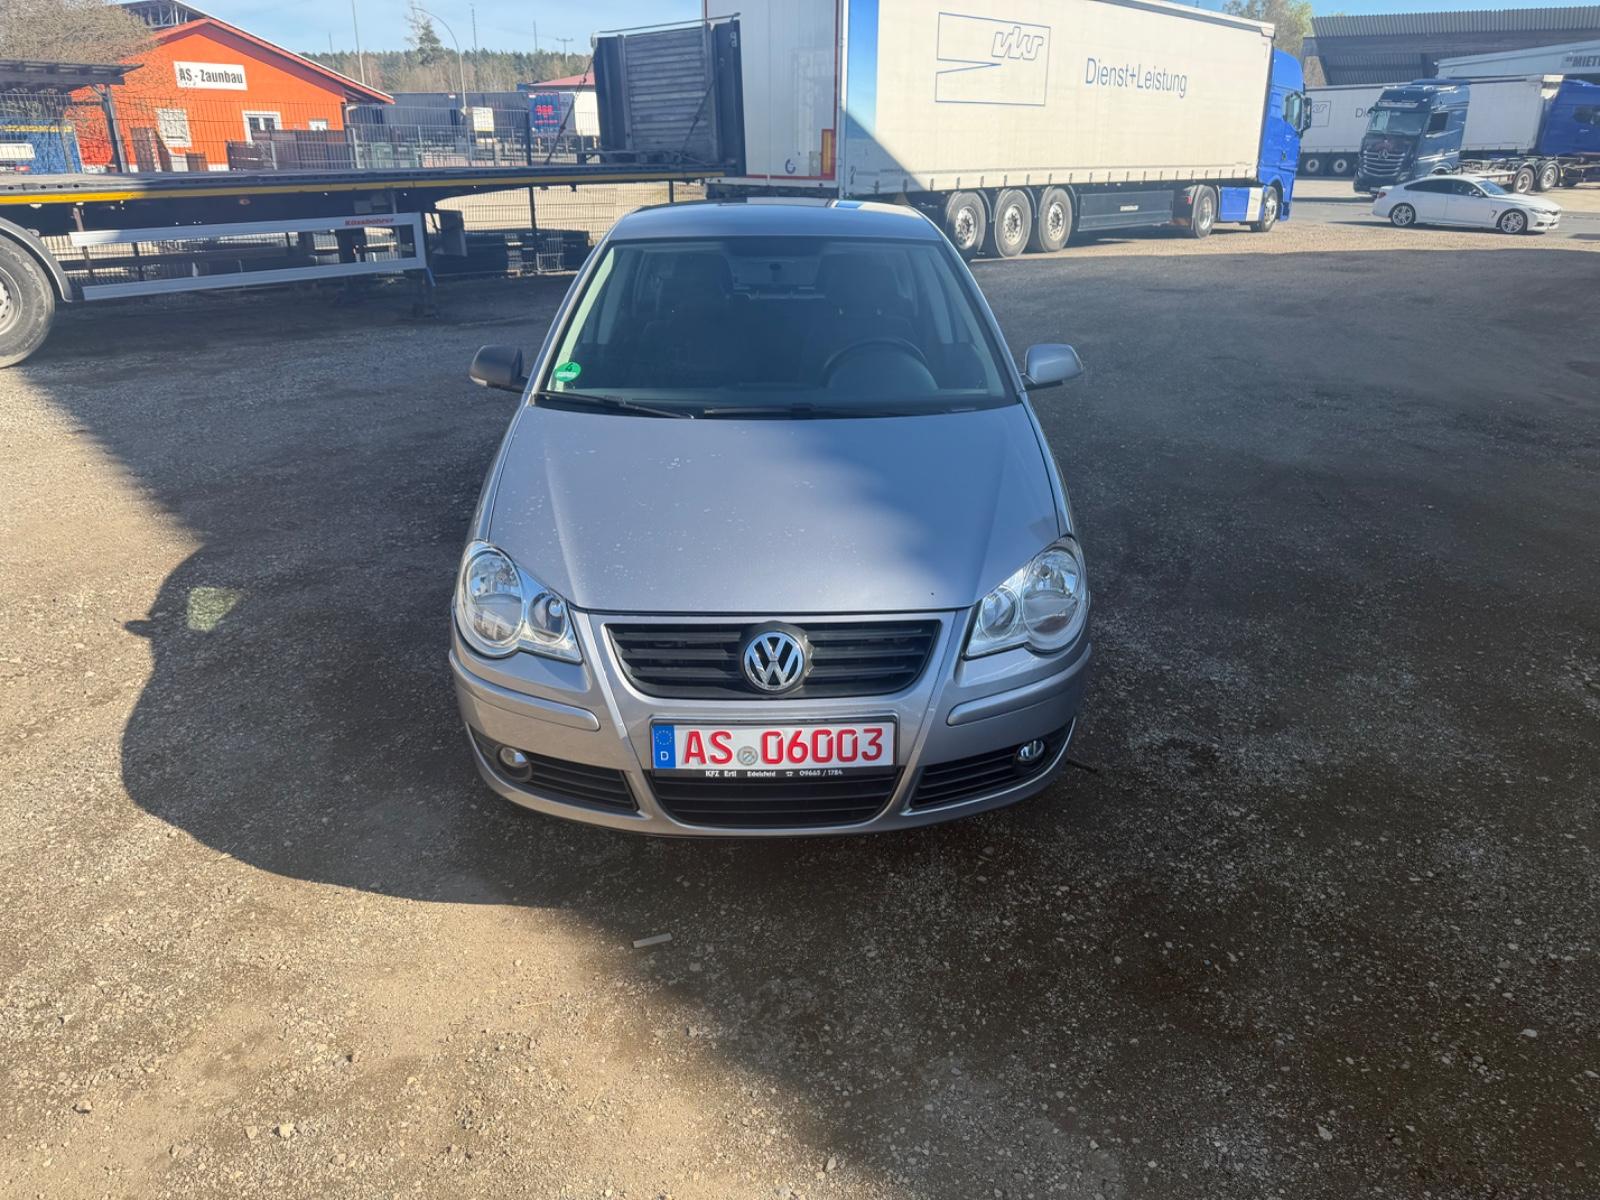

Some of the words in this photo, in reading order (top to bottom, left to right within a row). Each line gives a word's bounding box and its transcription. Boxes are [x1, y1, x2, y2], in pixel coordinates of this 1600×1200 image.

[179, 67, 193, 82] AS
[200, 69, 243, 84] Zaunbau
[1085, 57, 1188, 98] Dienst+Leistung
[660, 751, 669, 761] D
[684, 730, 734, 765] AS
[761, 728, 883, 765] 06003
